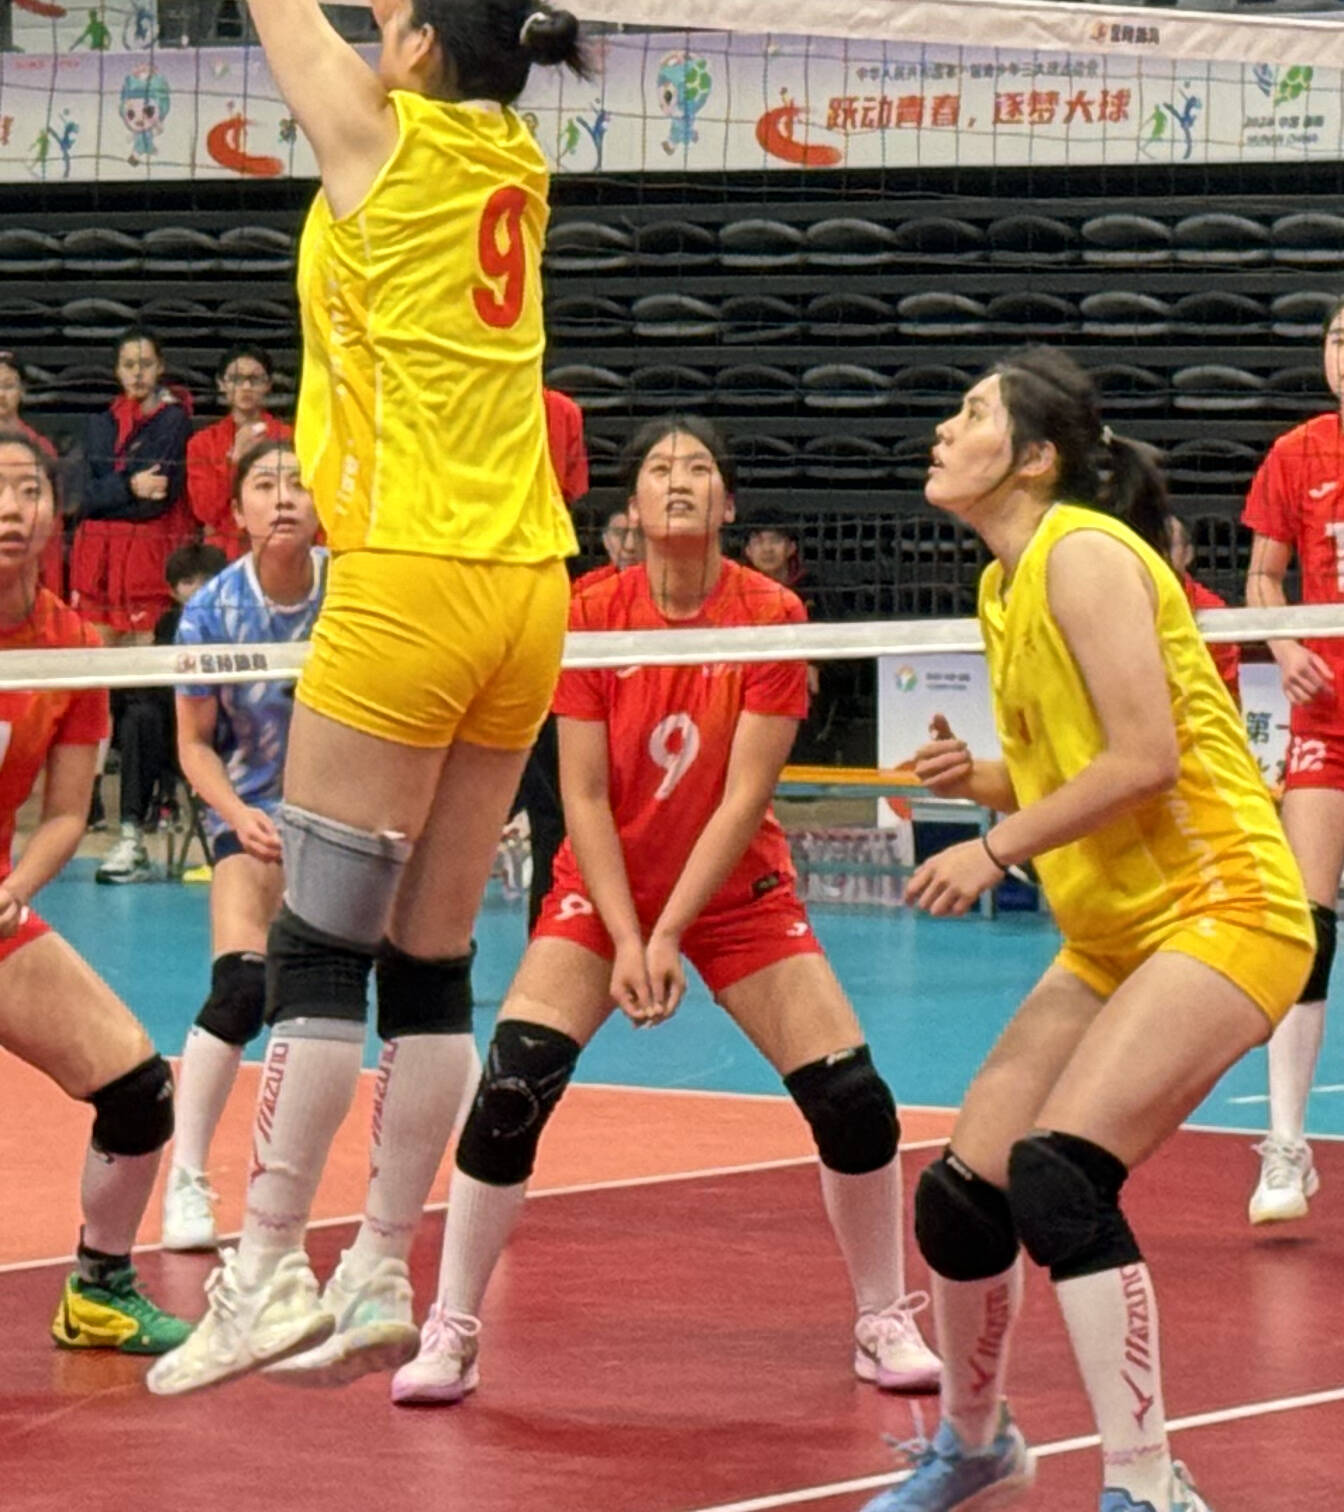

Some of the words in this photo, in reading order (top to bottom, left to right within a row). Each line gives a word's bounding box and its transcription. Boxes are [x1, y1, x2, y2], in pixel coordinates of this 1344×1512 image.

[472, 186, 527, 328] 9
[649, 711, 700, 801] 9
[1289, 736, 1326, 773] 12
[554, 891, 593, 920] 9
